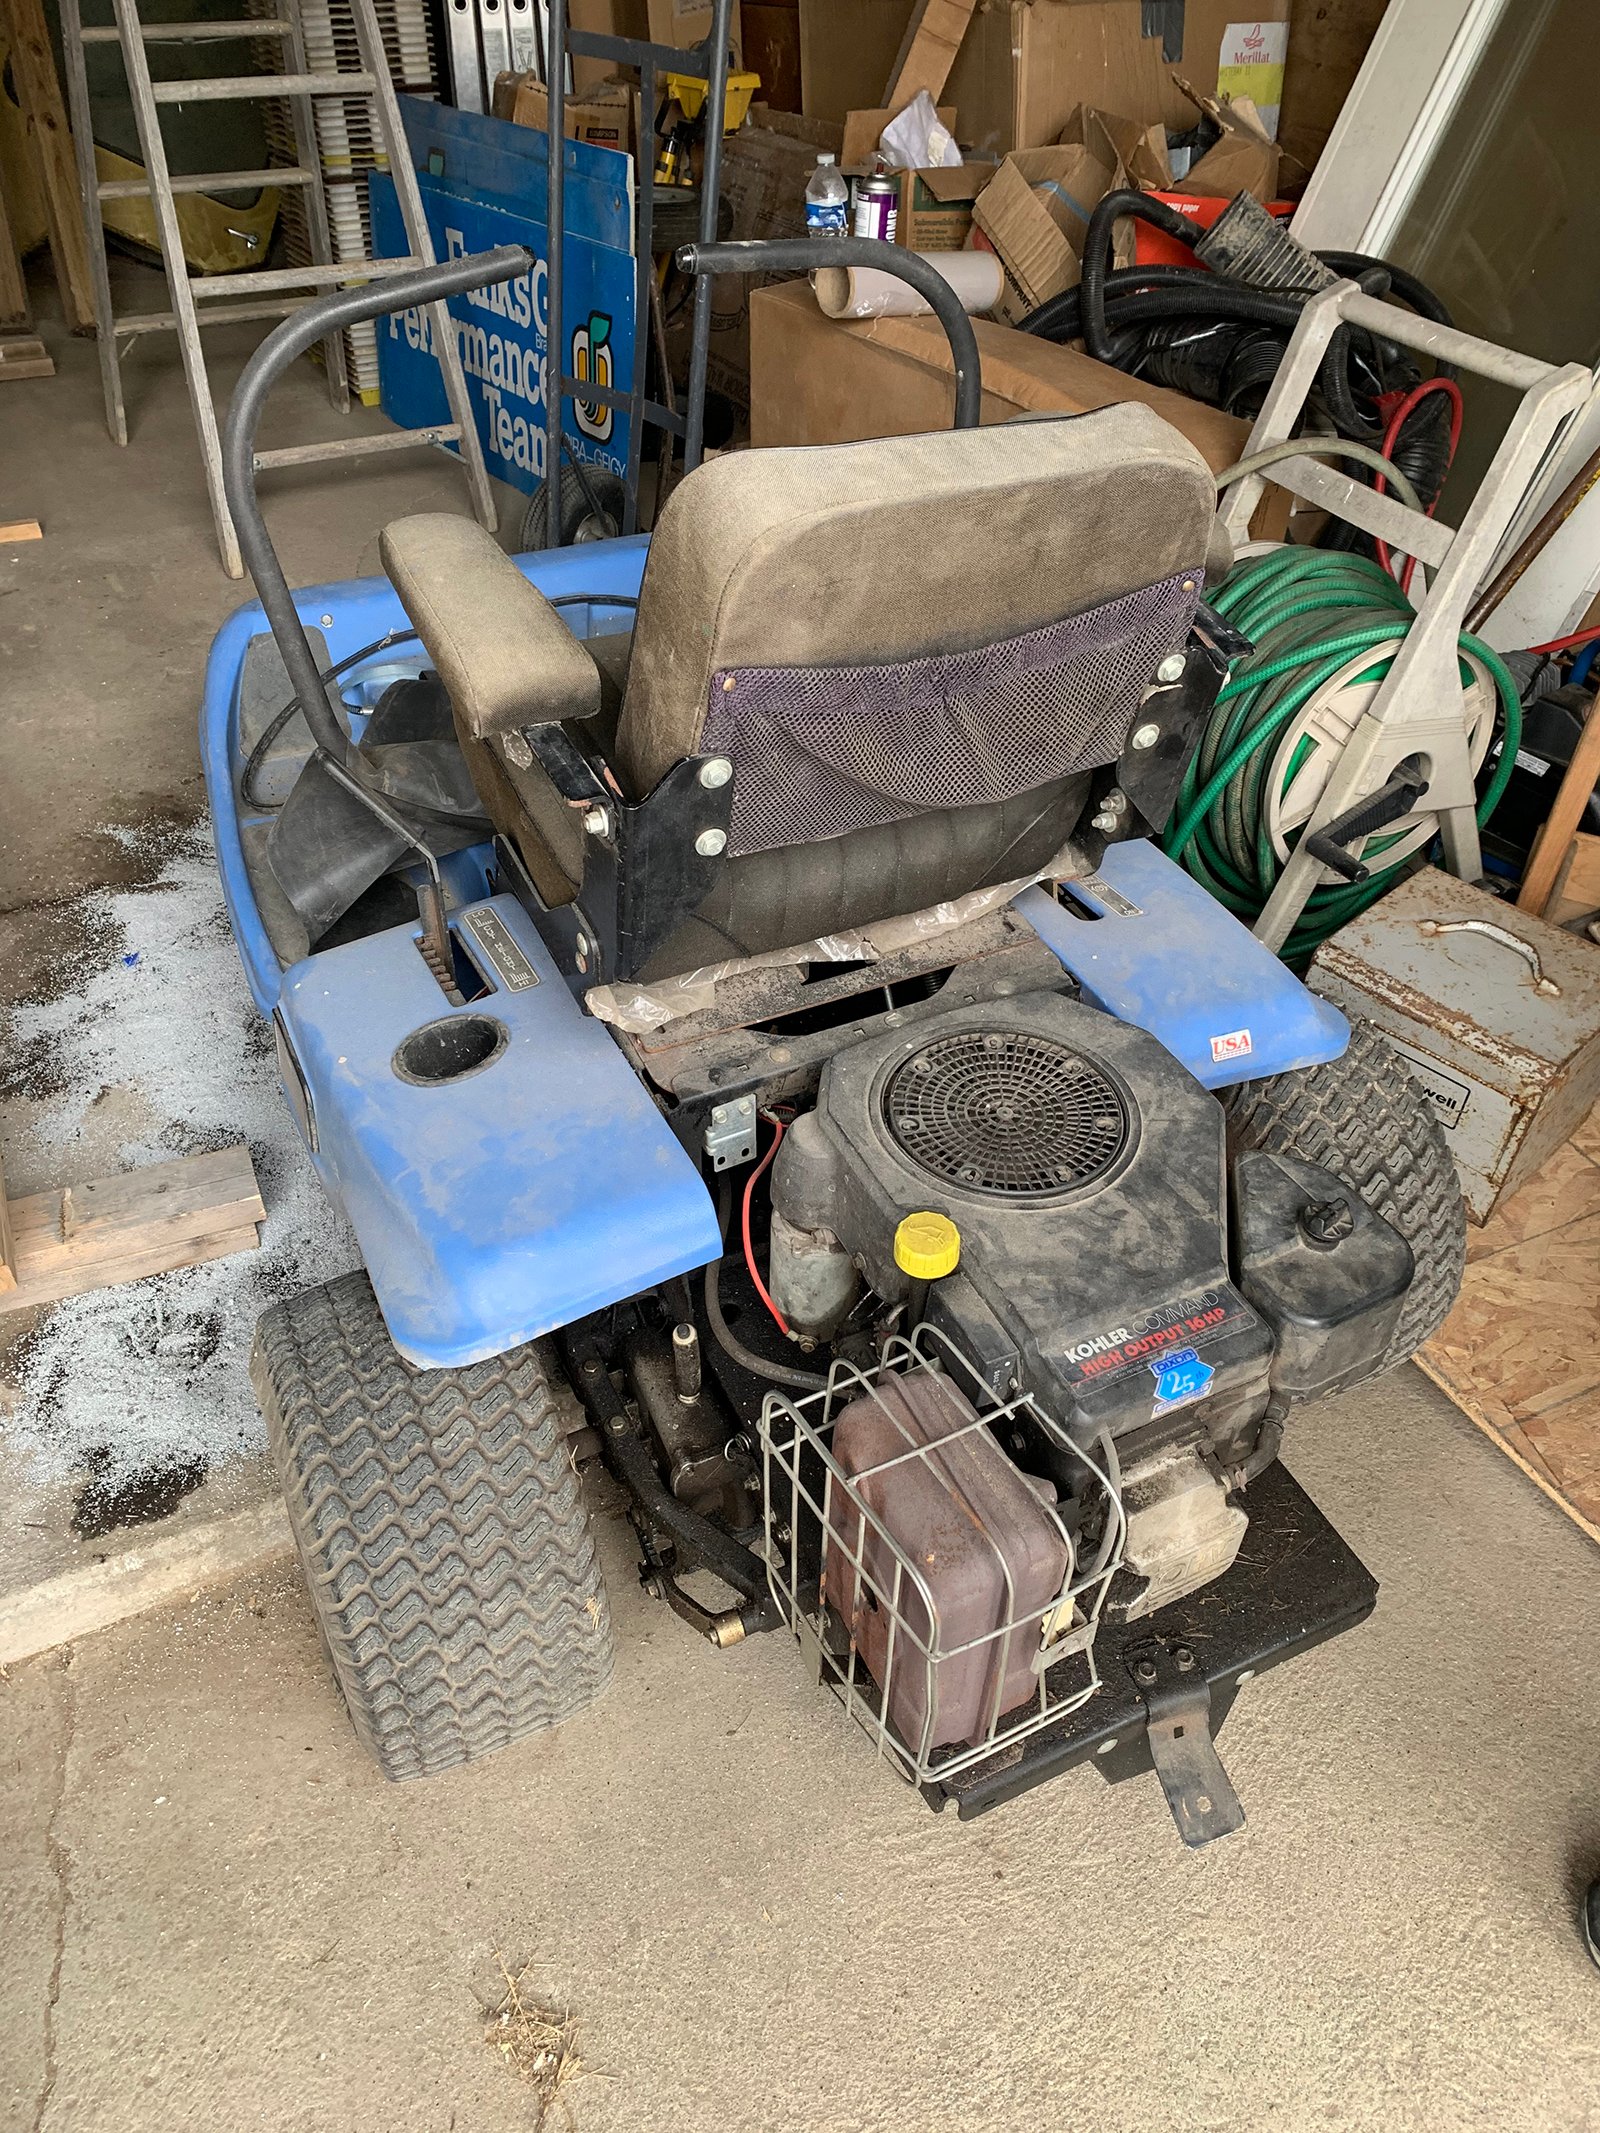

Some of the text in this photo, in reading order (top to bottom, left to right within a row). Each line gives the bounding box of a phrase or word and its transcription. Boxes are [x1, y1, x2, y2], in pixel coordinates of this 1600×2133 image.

[1233, 51, 1270, 64] Merillat
[1181, 203, 1200, 213] paper
[1213, 1034, 1250, 1055] USA
[1421, 1085, 1457, 1109] well
[1064, 1327, 1134, 1364] KOHLER
[1132, 1292, 1219, 1335] COMMAND
[1078, 1347, 1126, 1376] HIGH
[1123, 1323, 1186, 1357] OUTPUT
